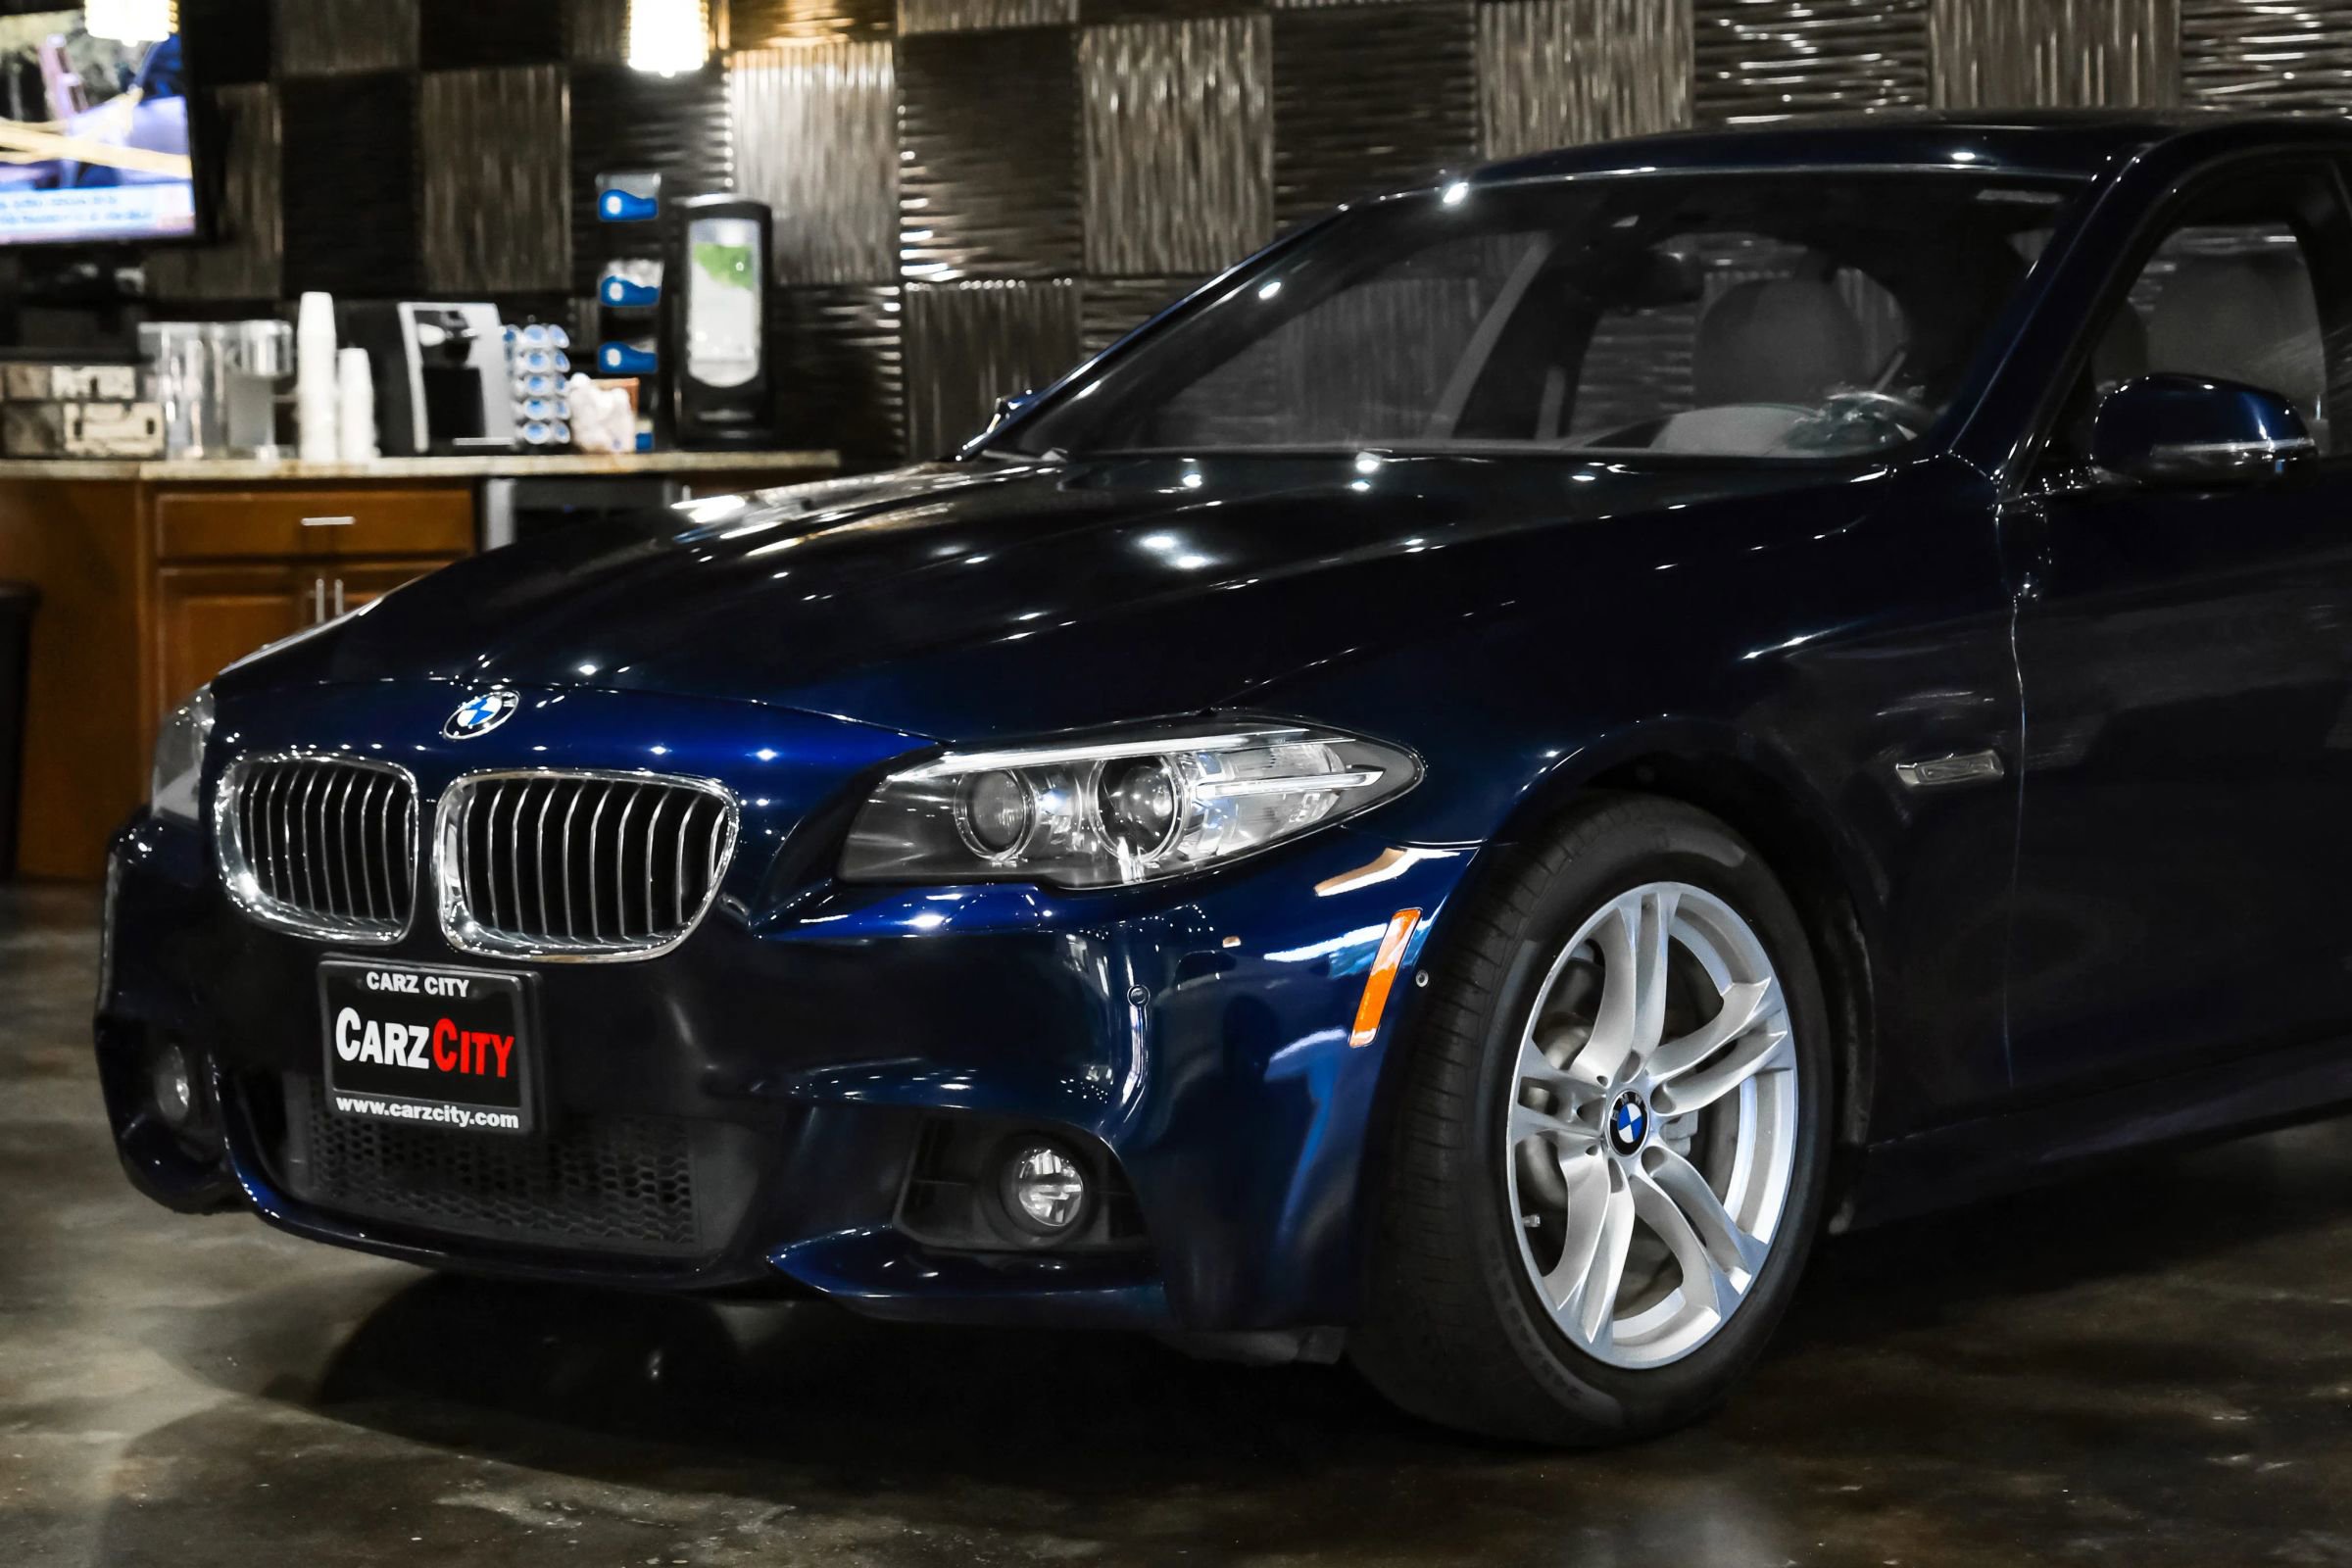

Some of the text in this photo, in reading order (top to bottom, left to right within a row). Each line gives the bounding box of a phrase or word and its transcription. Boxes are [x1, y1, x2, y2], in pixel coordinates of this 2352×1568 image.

[367, 971, 469, 998] CARZ CITY
[336, 1097, 518, 1129] www.carzcity.com
